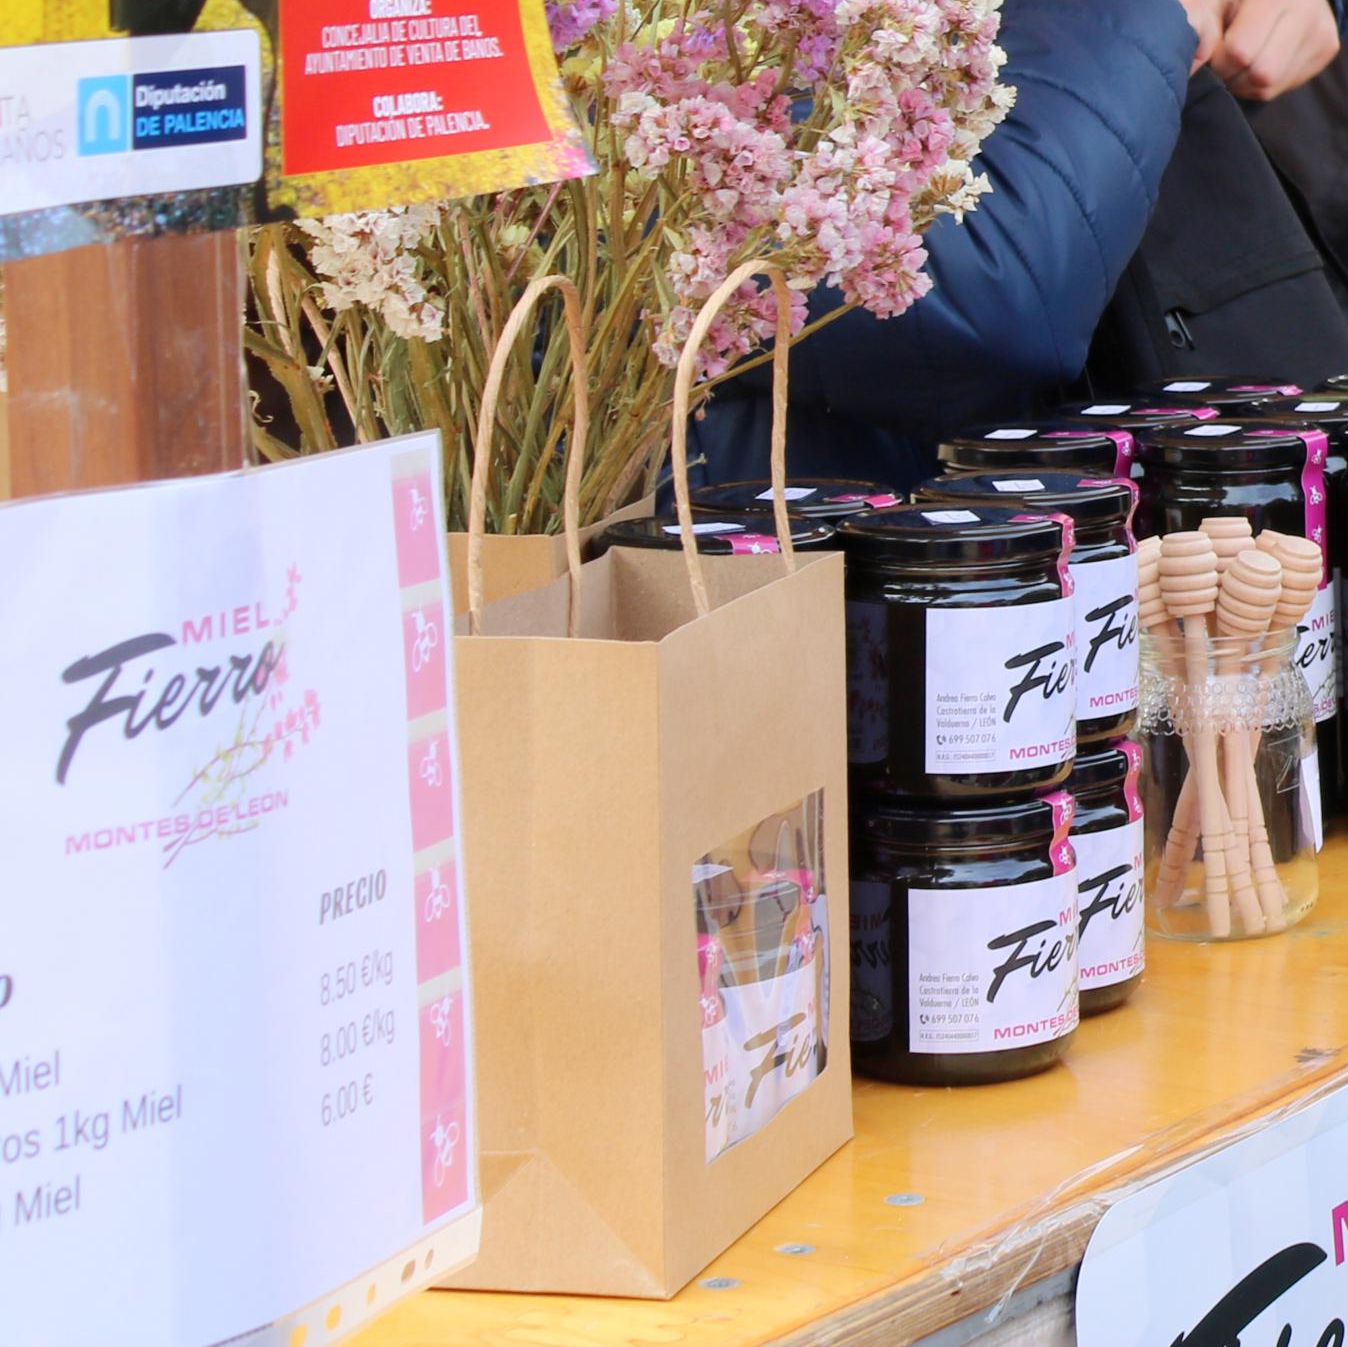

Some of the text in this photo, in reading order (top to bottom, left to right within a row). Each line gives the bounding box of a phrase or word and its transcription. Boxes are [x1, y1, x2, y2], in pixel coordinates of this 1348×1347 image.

[391, 20, 407, 43] DE
[408, 16, 458, 41] CULTURA
[304, 39, 461, 75] AYUNTAMIENTO DE VENTA DE
[135, 78, 227, 111] Diputación
[372, 91, 444, 118] COLABORA:
[136, 107, 245, 138] DE PALENCIA
[335, 110, 490, 147] DIPUTACIÓN DE PALENCIA.
[181, 601, 270, 647] MIEL
[56, 631, 284, 786] Fierro
[1009, 734, 1070, 760] MONTES
[64, 813, 190, 856] MONTES
[319, 867, 387, 926] PRECIO
[320, 960, 356, 1007] 8.50
[360, 949, 394, 987] €/kg
[1080, 954, 1140, 980] MONTES
[994, 1014, 1066, 1040] MONTES
[54, 1007, 395, 1151] 1kg Miel 8.00 €/kg
[14, 1071, 374, 1227] Miel 6.00 €
